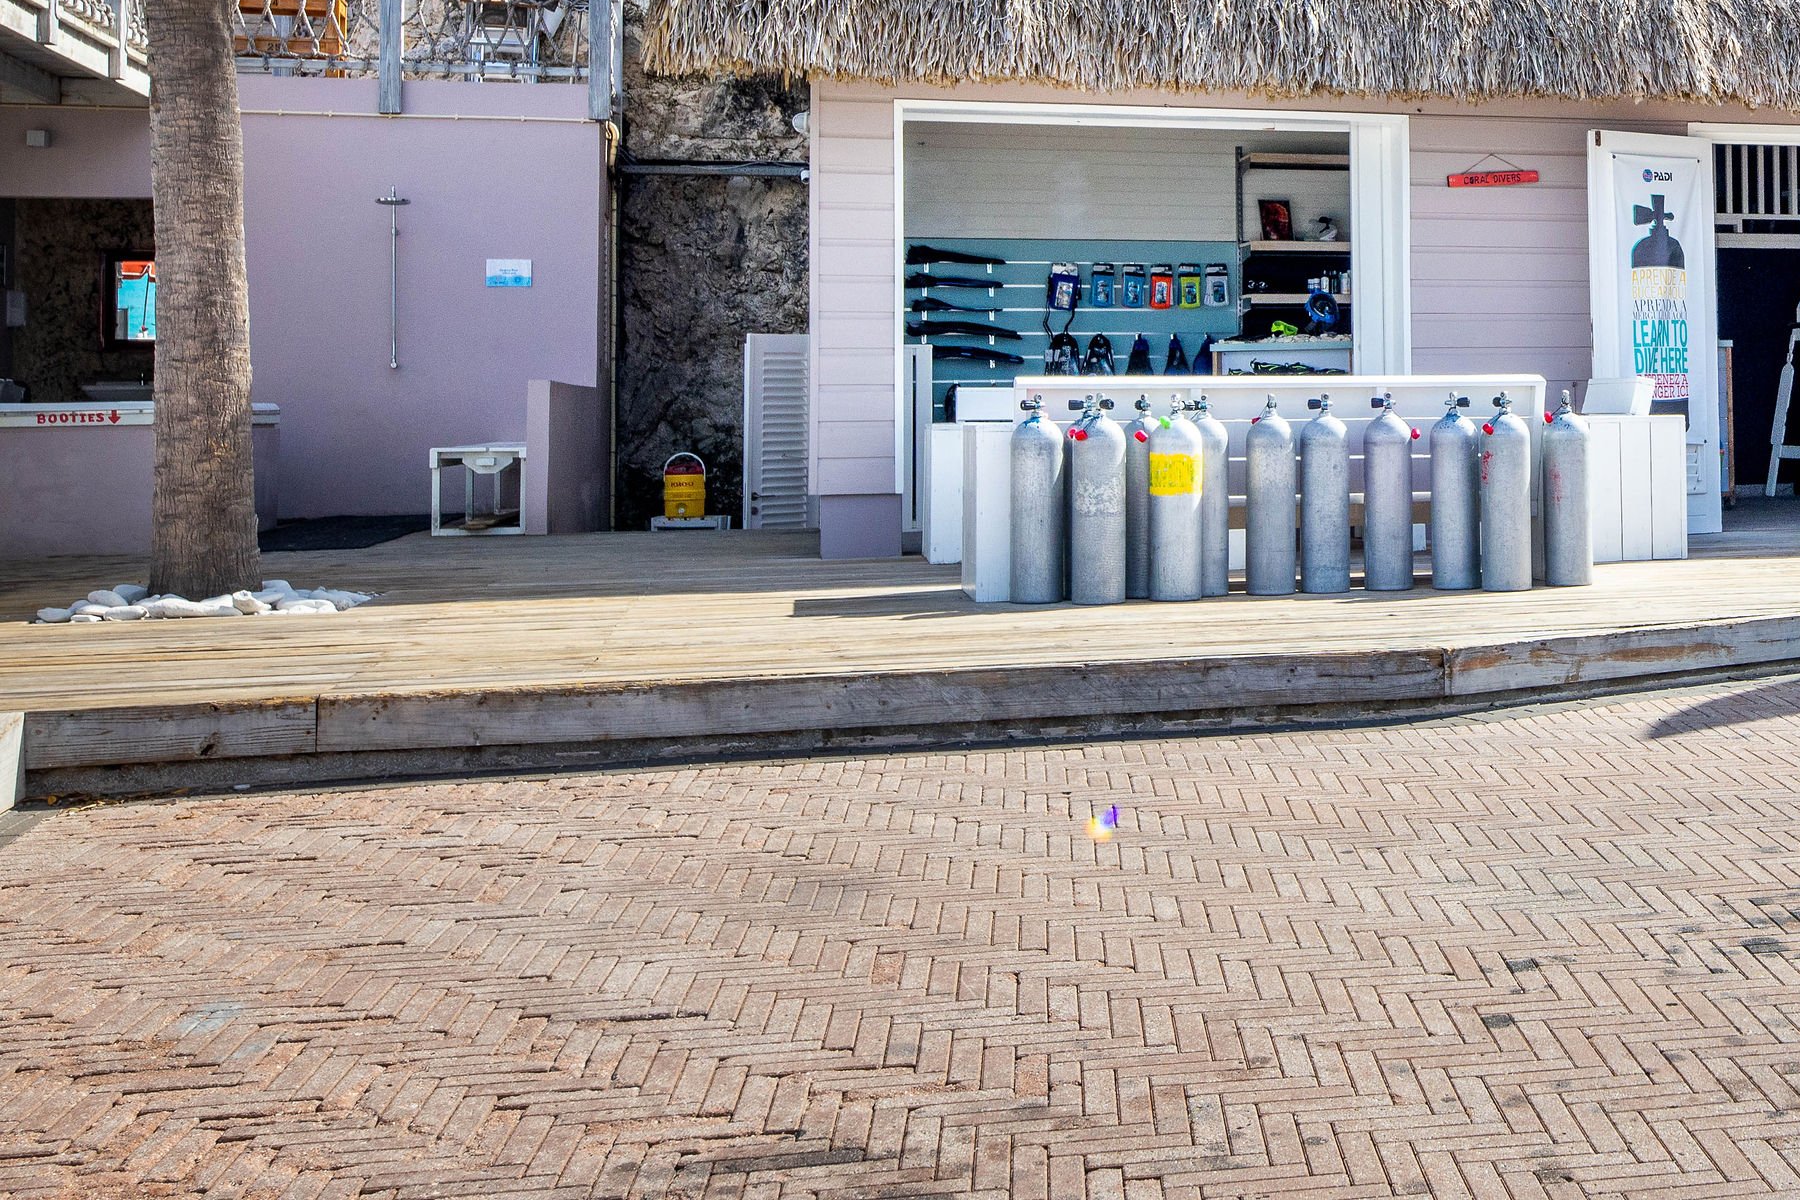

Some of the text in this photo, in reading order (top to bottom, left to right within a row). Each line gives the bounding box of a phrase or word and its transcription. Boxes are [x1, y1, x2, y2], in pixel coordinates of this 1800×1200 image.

[1463, 173, 1521, 185] CORAL DIVERS
[1653, 171, 1673, 181] PADI
[1632, 269, 1687, 286] APRENDE A
[1633, 299, 1687, 312] APRENDA A
[1632, 319, 1688, 347] LEARN TO
[1634, 348, 1689, 374] DIVE HERE
[1652, 385, 1689, 398] NGER ICI
[36, 412, 105, 424] BOOTIES
